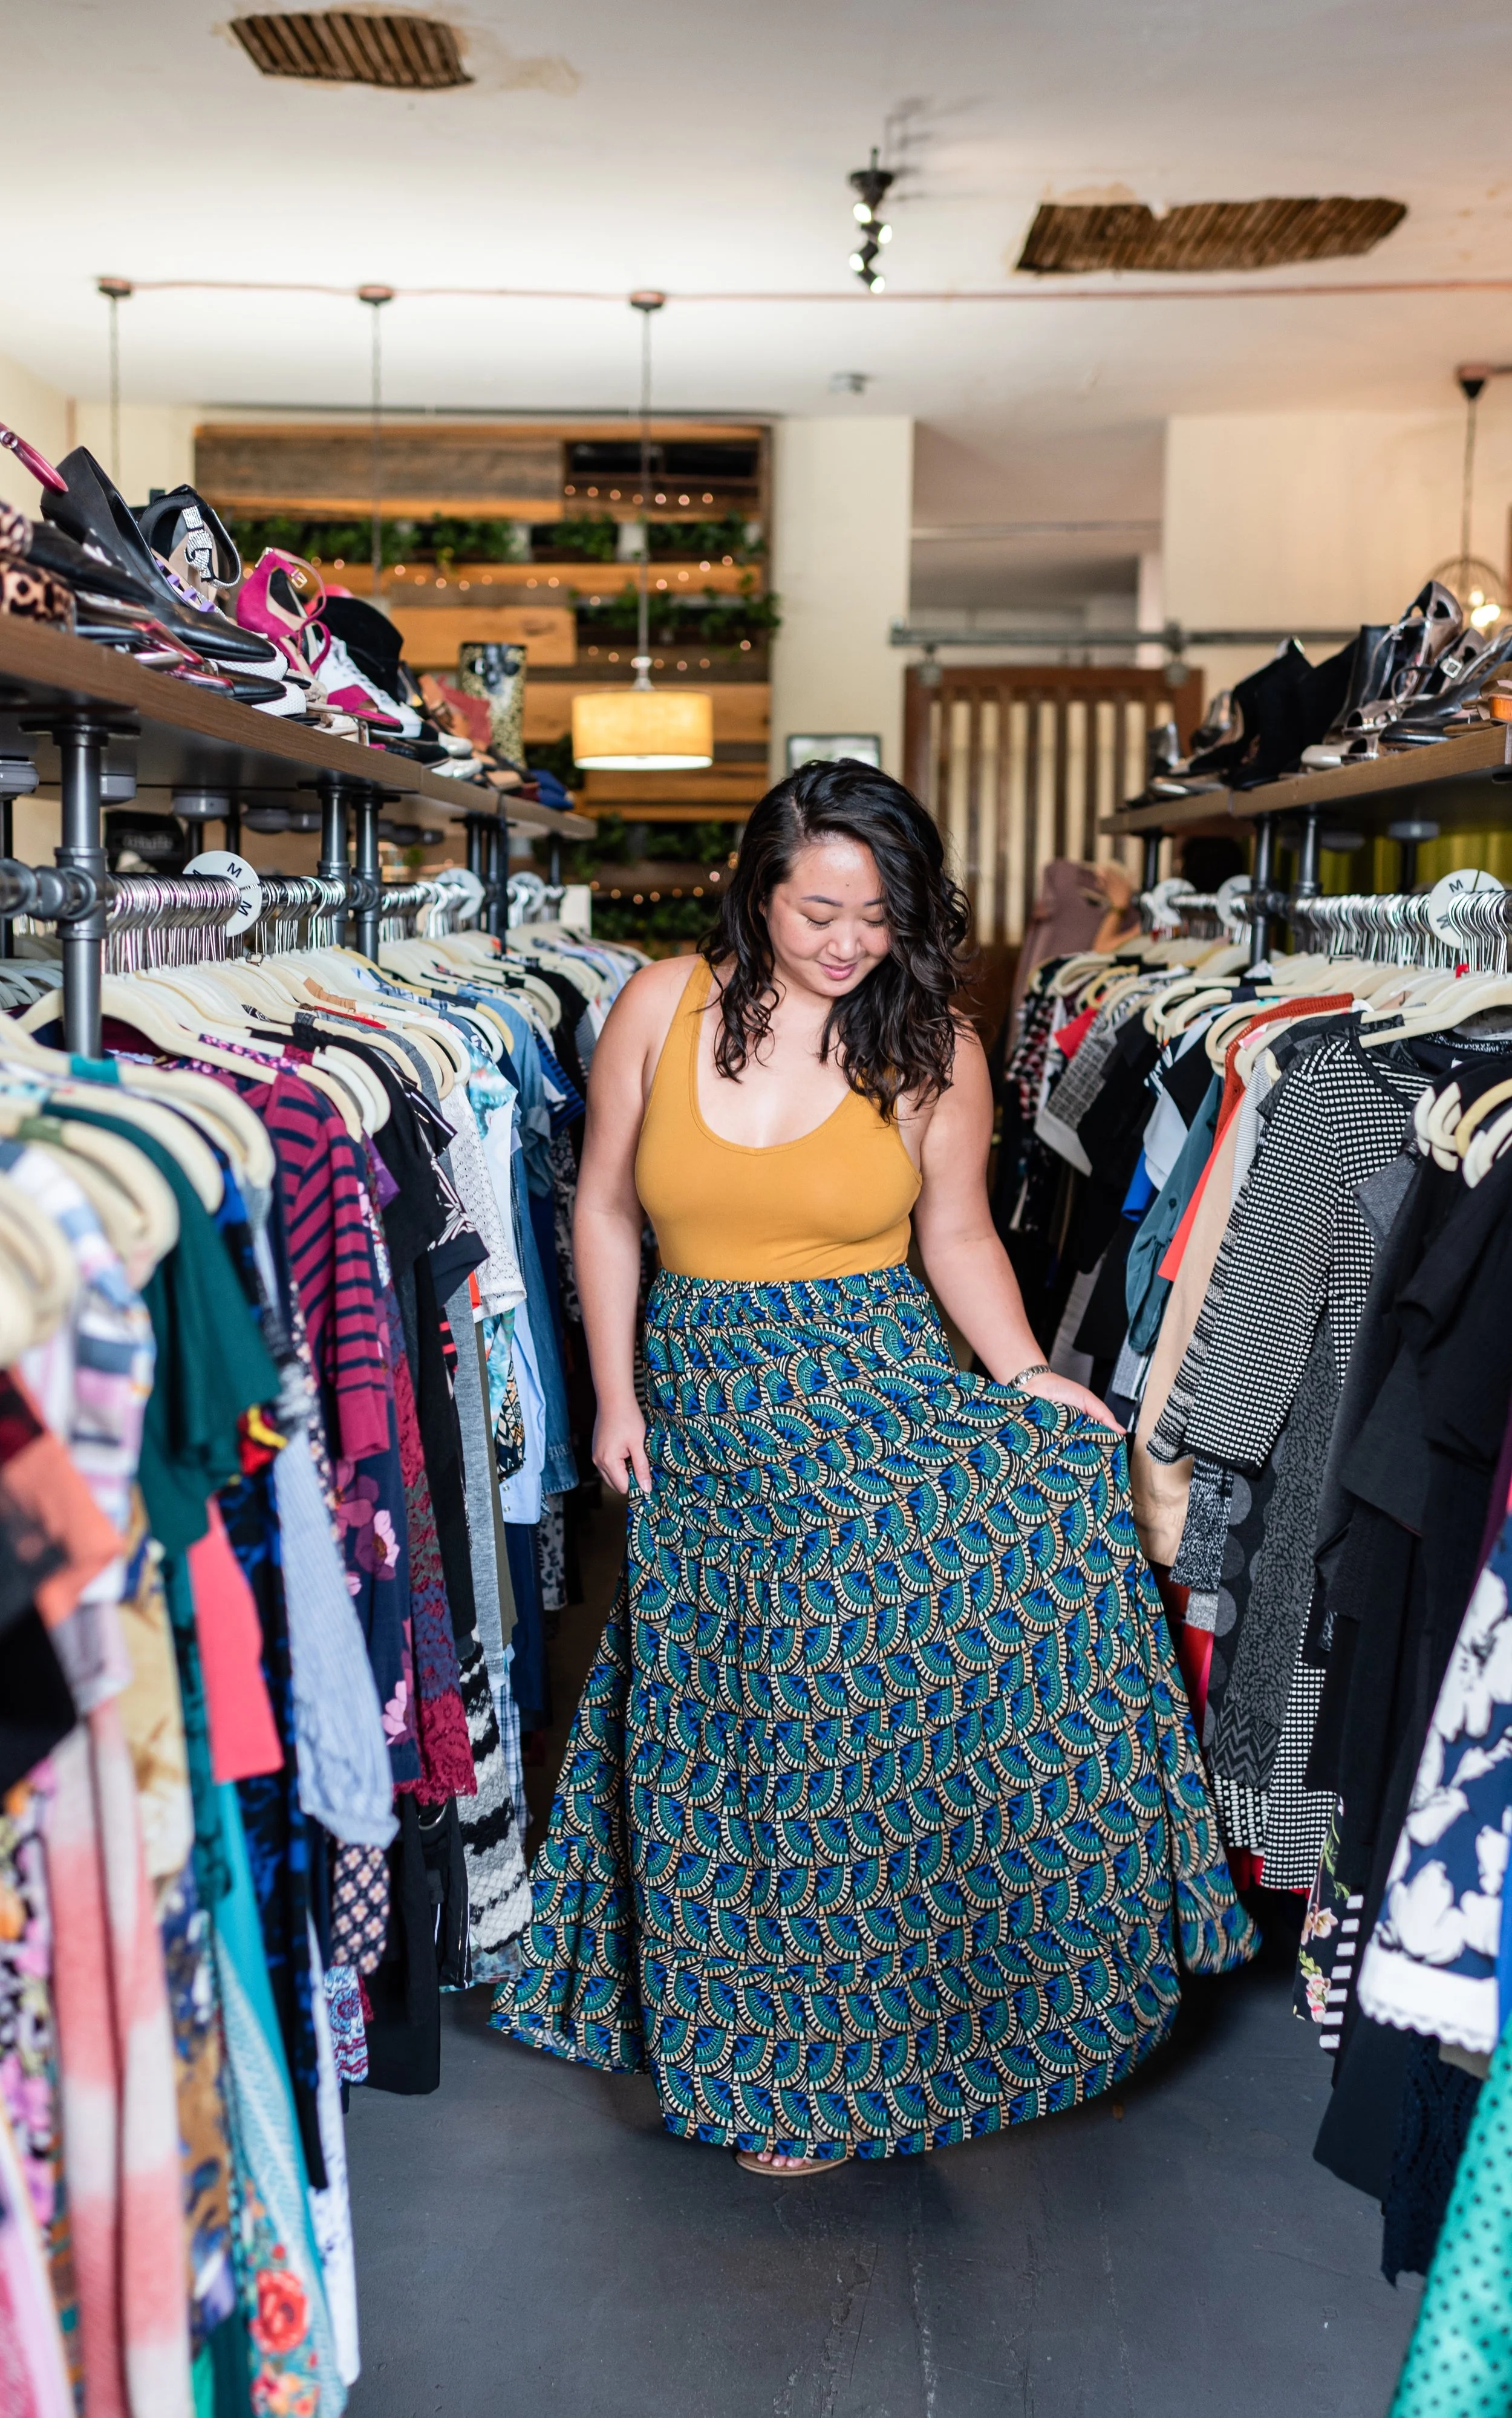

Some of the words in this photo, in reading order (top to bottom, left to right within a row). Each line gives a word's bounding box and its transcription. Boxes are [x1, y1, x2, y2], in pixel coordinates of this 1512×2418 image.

[227, 862, 242, 878] M
[1448, 879, 1463, 893] M
[238, 901, 252, 916] M
